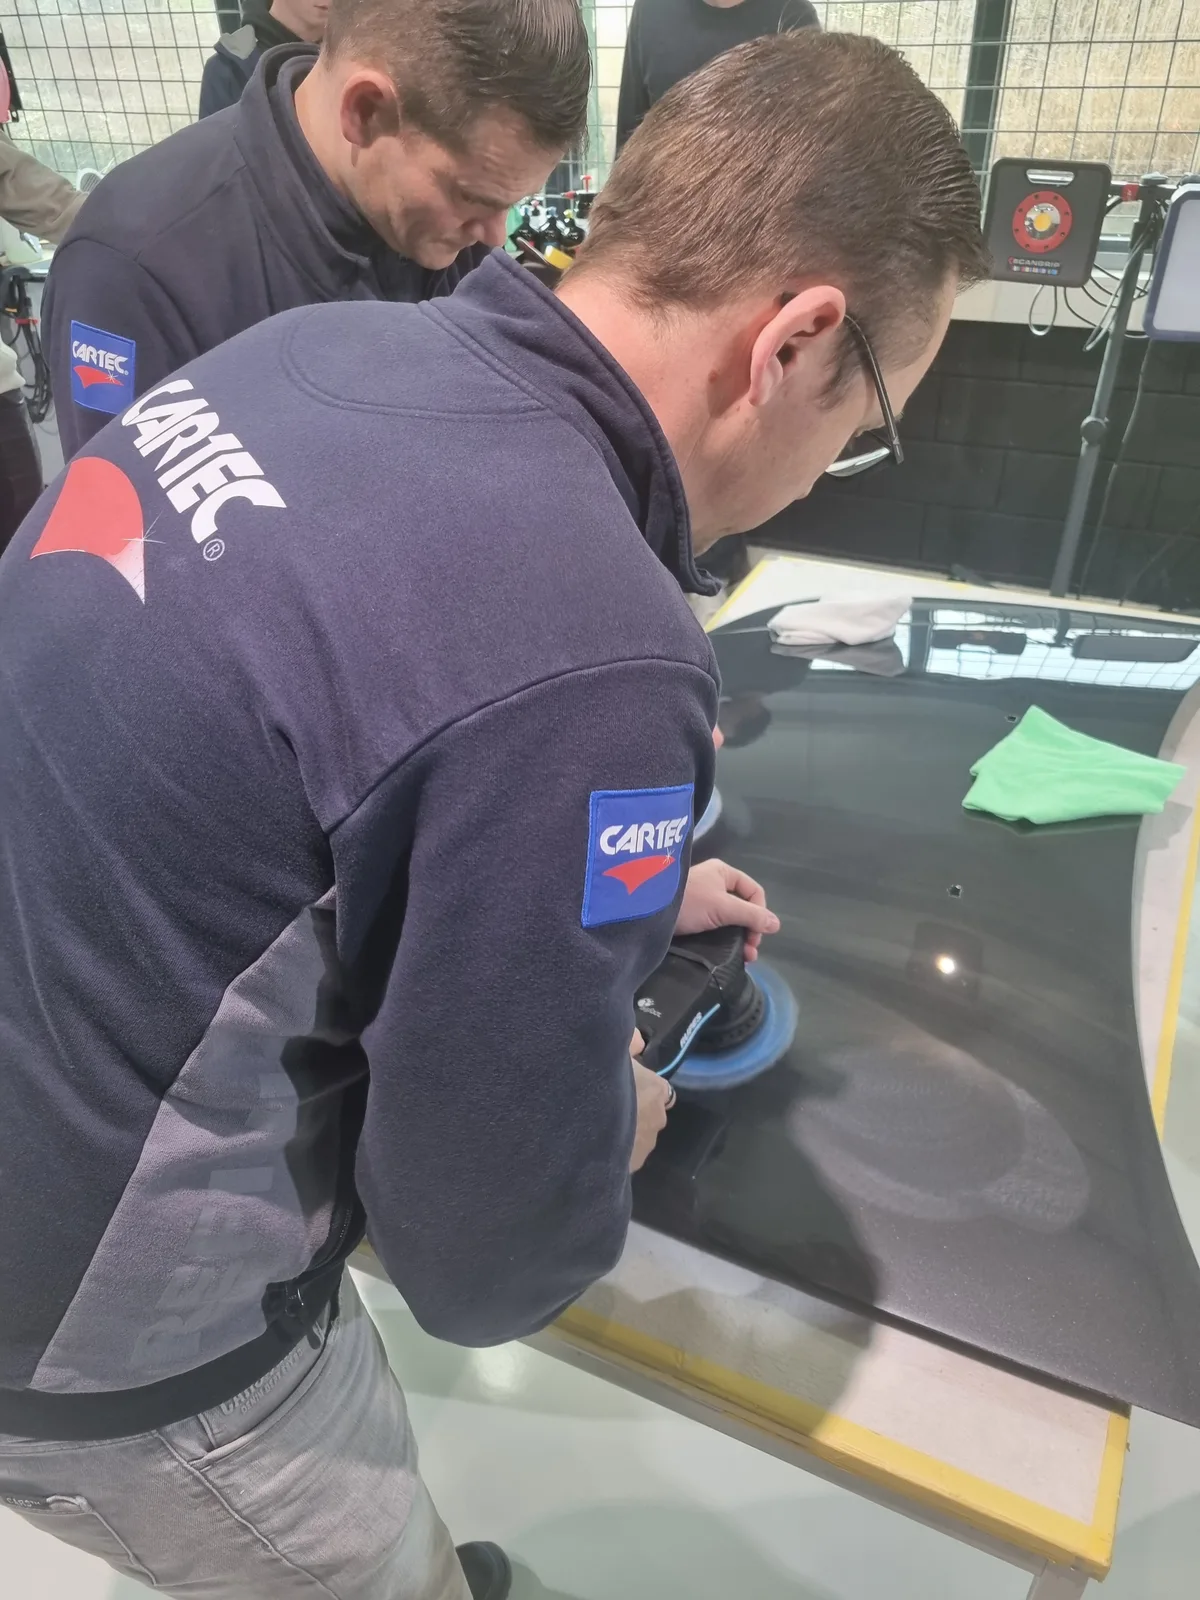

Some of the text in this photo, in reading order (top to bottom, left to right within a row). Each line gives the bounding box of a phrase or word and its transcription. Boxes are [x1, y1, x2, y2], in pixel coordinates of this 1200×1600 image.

[72, 340, 129, 374] CARTEC
[121, 379, 287, 544] CARTEC
[600, 815, 688, 855] CARTEC
